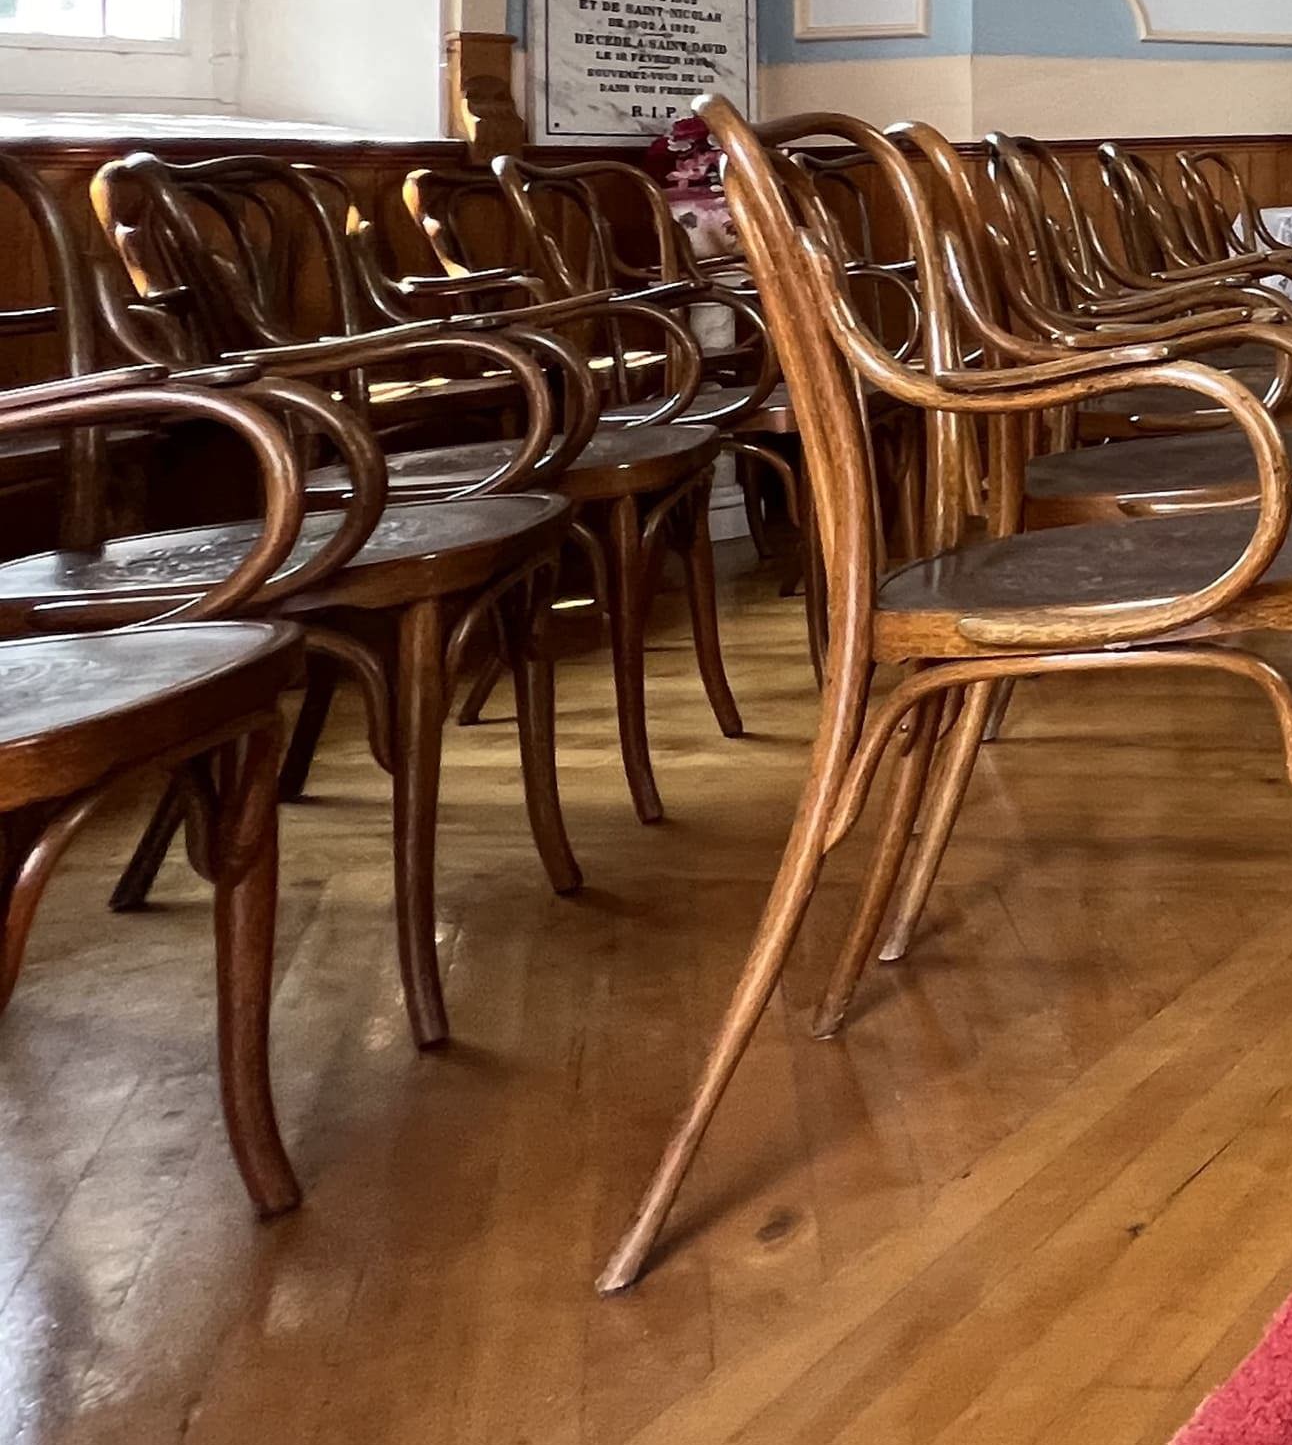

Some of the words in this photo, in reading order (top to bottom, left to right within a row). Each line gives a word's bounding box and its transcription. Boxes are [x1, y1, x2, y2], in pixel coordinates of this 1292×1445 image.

[602, 1, 620, 12] DE
[625, 4, 722, 22] SAINT-NICOLAS
[608, 17, 624, 28] DE
[596, 51, 611, 60] LE
[681, 74, 695, 83] DE
